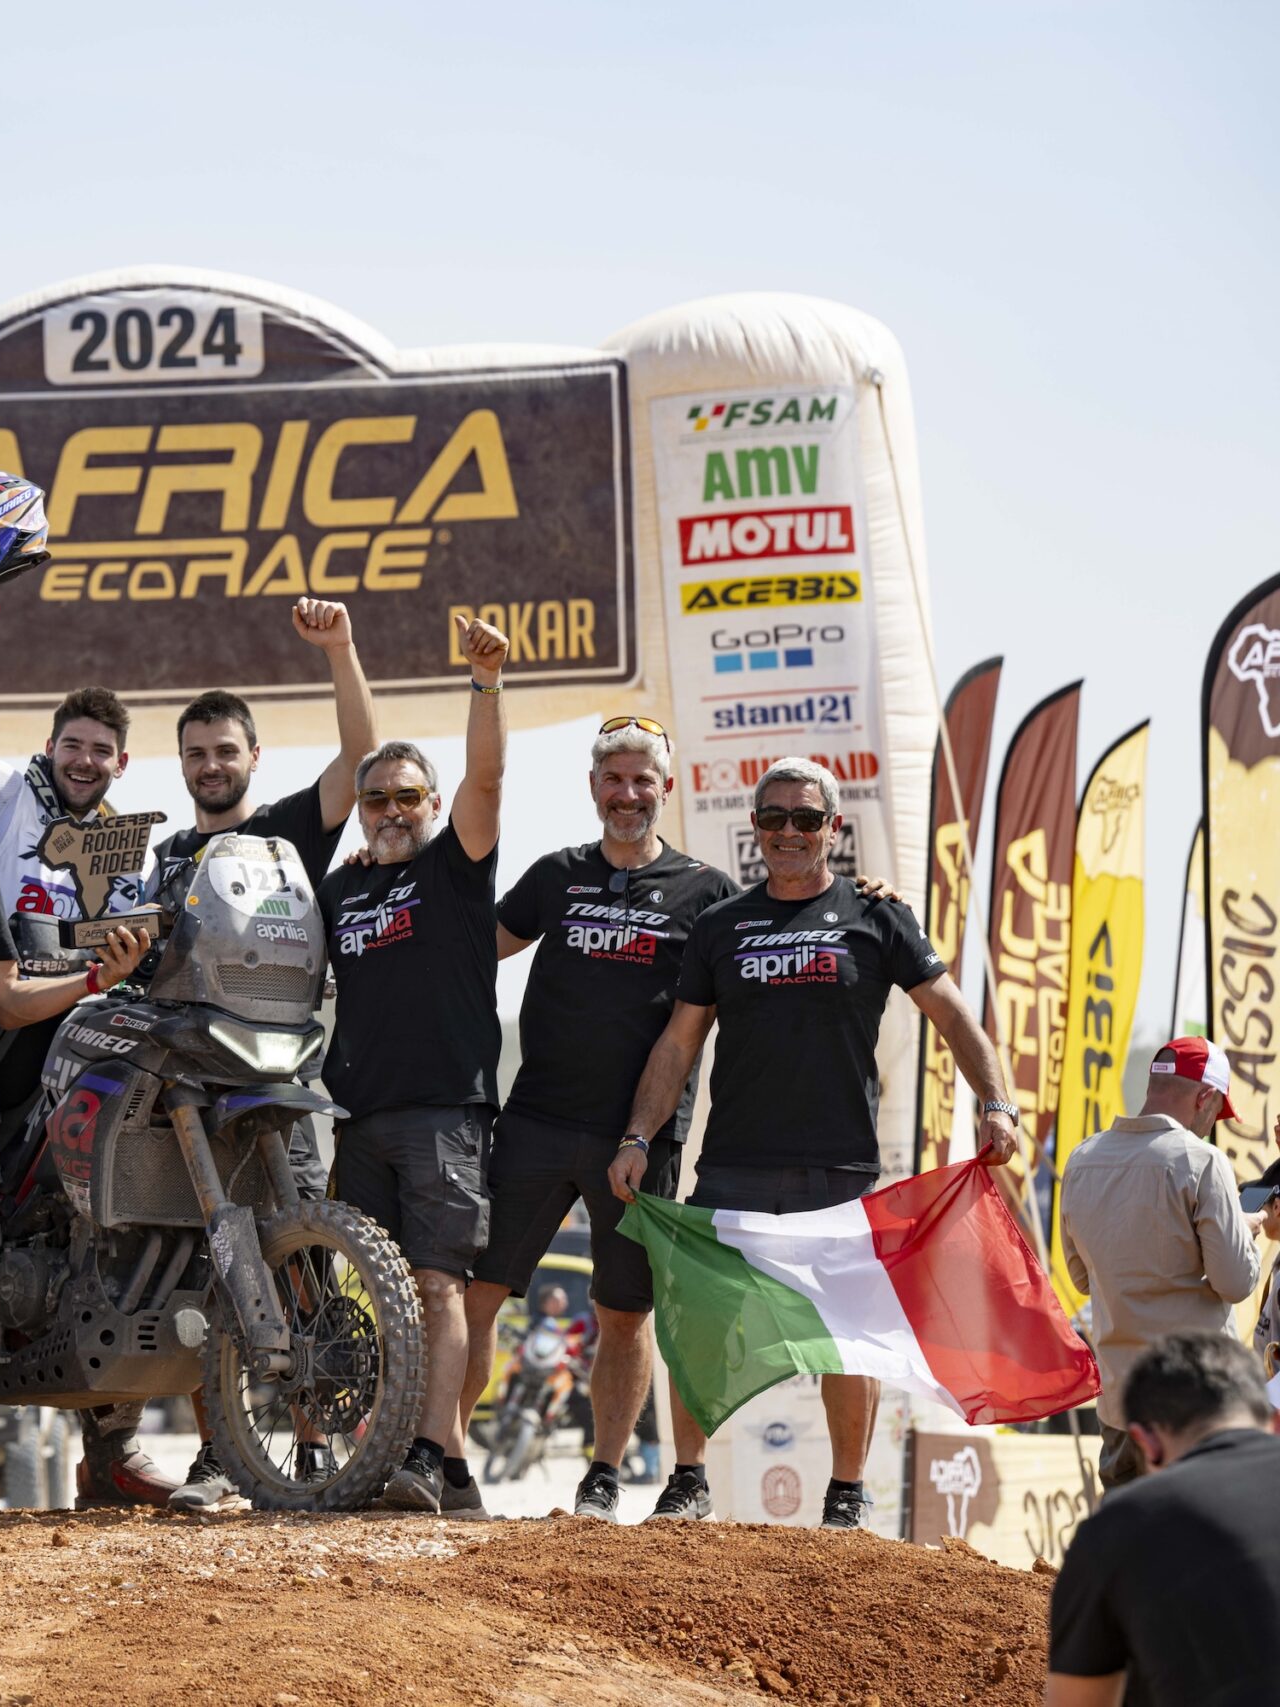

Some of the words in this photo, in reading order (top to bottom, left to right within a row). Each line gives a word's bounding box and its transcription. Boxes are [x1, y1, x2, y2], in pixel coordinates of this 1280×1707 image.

[70, 306, 242, 373] 2024
[723, 398, 838, 429] FSAM
[688, 512, 849, 560] MOTUL
[686, 577, 858, 611] ACERBIS
[711, 624, 845, 651] GoPro
[713, 694, 852, 729] stand21
[82, 827, 149, 855] ROOKIE
[89, 850, 144, 876] RIDER
[256, 921, 308, 943] aprilia
[365, 929, 414, 950] ACING
[566, 924, 657, 957] aprilia
[737, 929, 849, 950] TUAREG
[591, 951, 654, 965] RACING
[740, 945, 838, 983] aprilia
[769, 975, 838, 986] RACING
